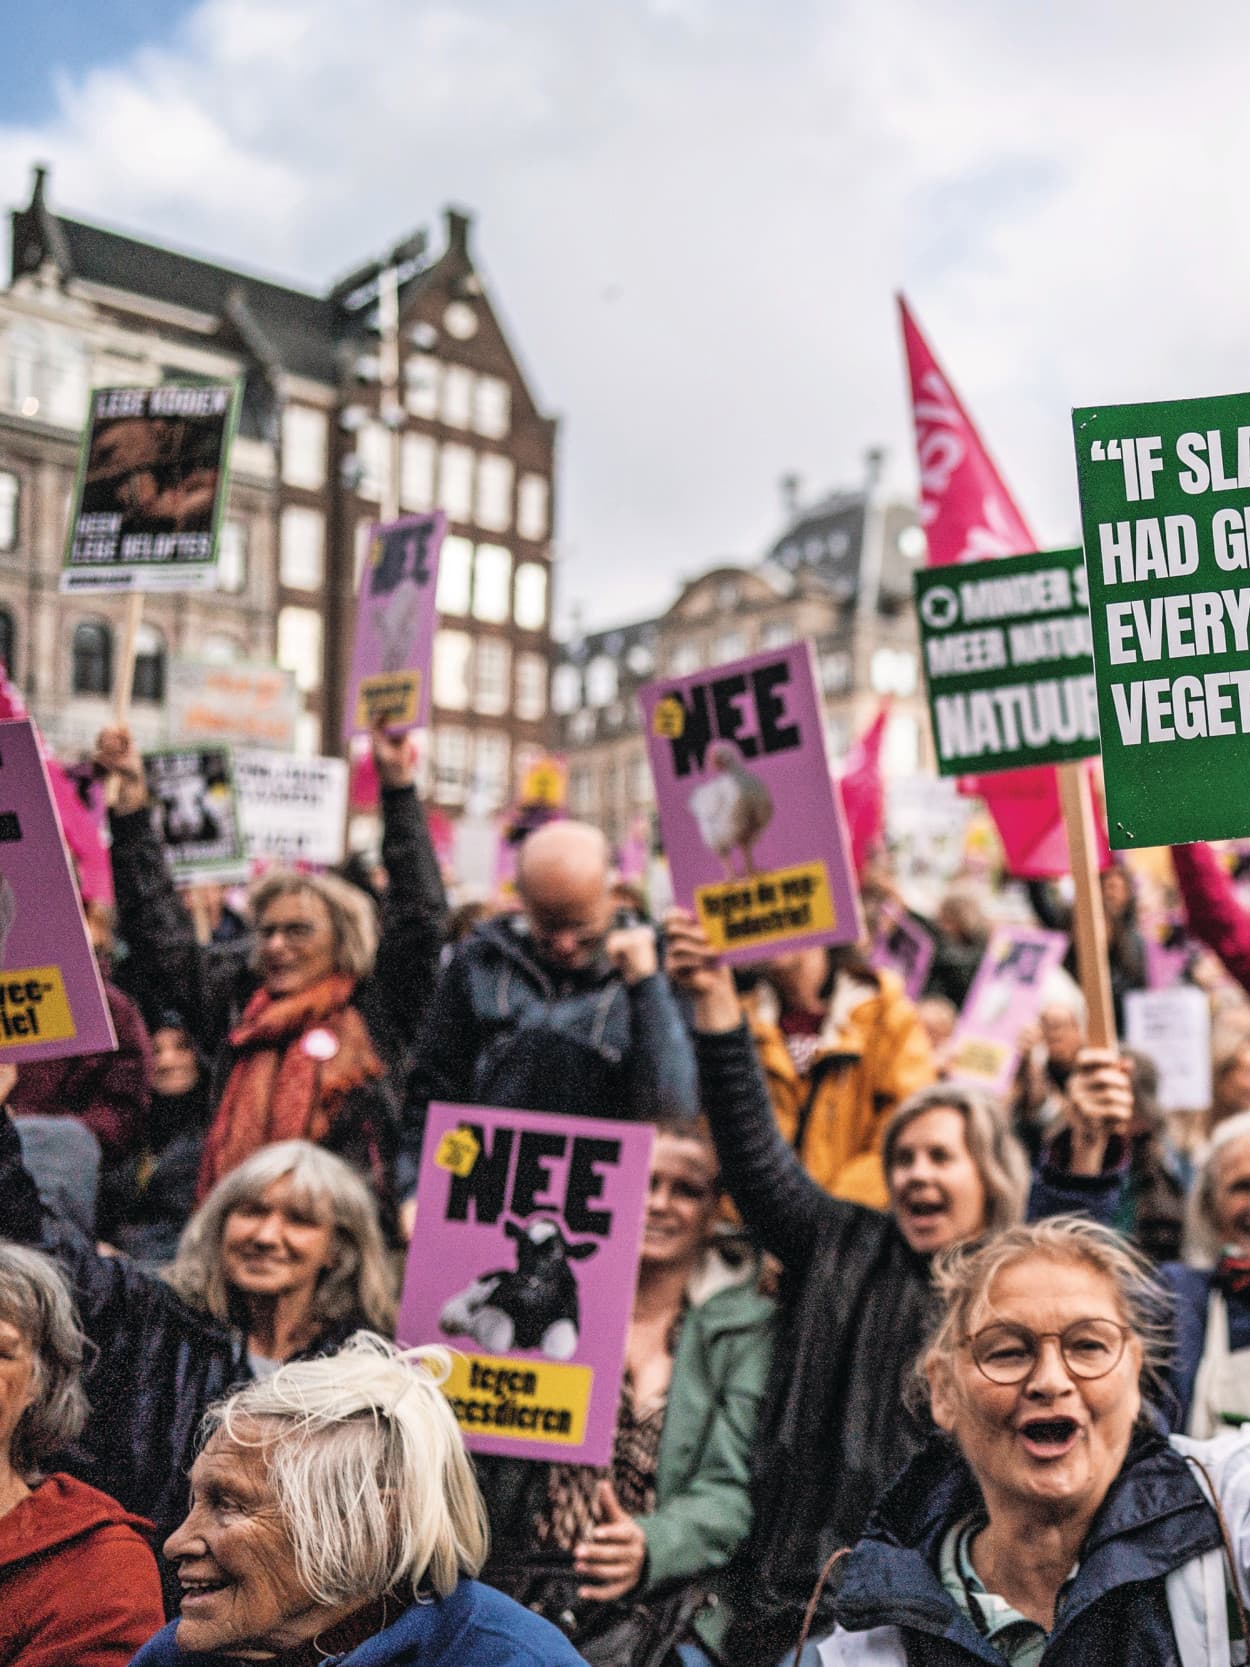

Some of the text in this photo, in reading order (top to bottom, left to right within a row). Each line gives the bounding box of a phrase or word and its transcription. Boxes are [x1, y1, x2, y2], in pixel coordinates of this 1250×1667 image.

[1098, 515, 1199, 585] HAD
[962, 569, 1071, 622] MINDER
[926, 628, 1006, 676] MEER
[669, 664, 800, 778] NEE
[445, 1123, 621, 1237] NEE
[469, 1361, 537, 1397] tegen
[449, 1396, 572, 1434] eesdieren
